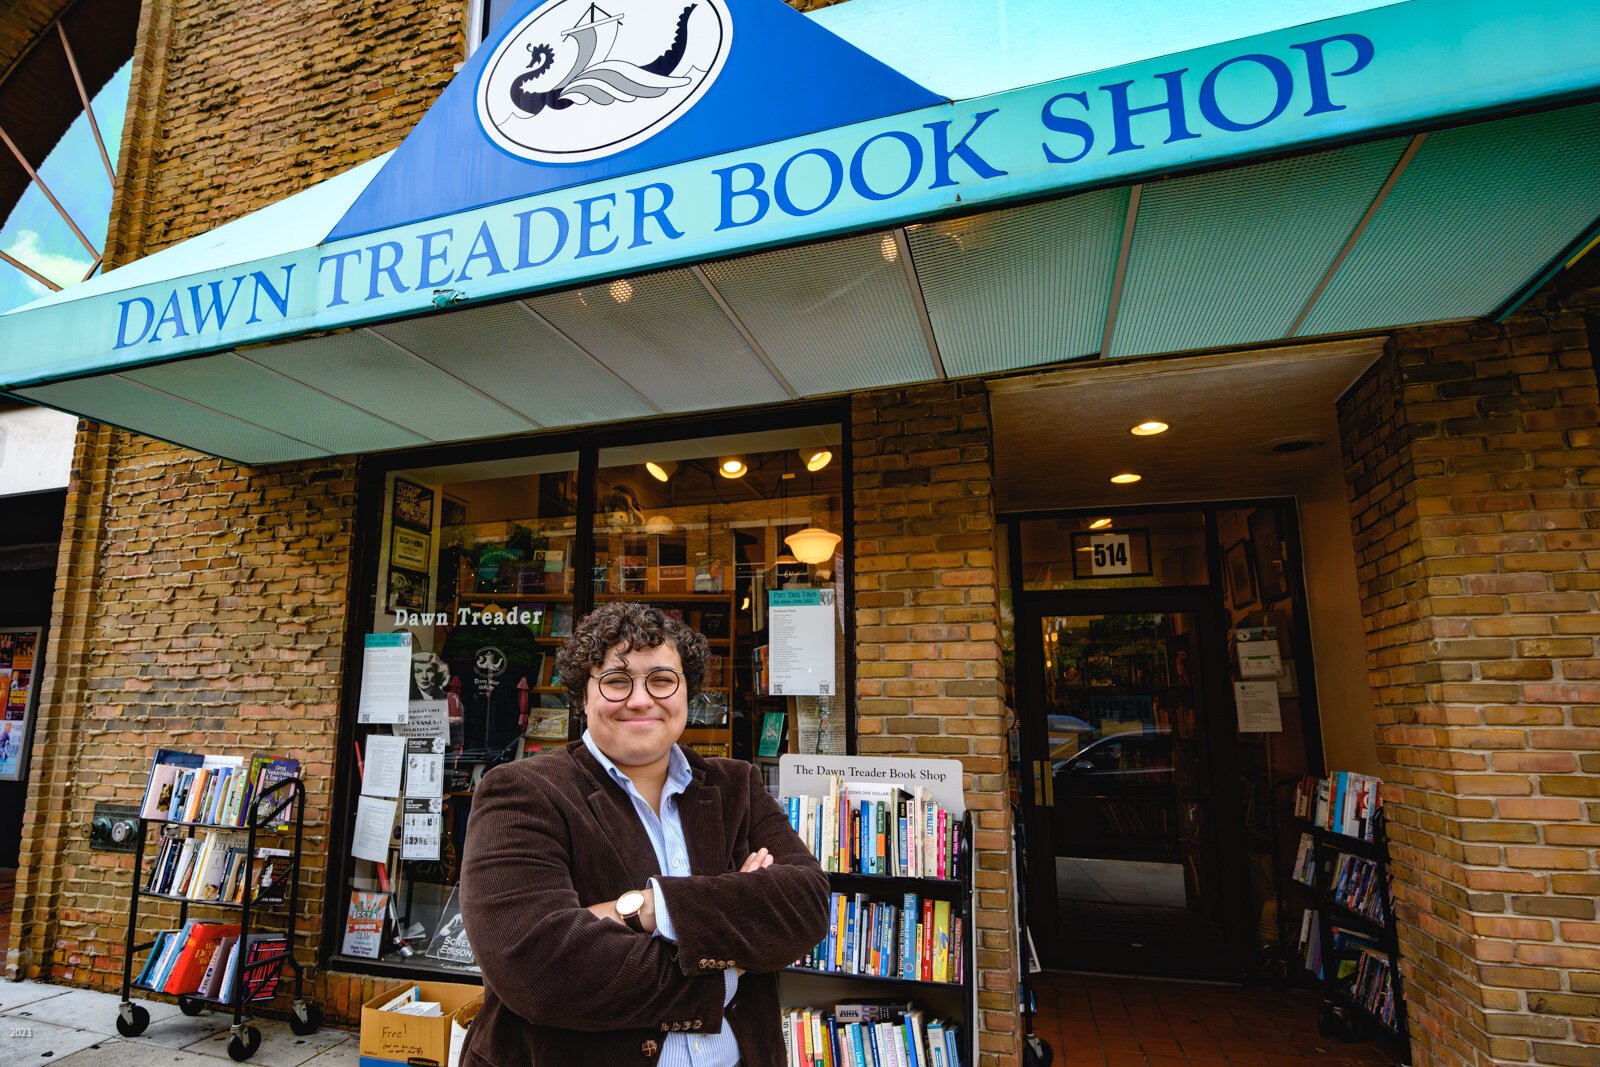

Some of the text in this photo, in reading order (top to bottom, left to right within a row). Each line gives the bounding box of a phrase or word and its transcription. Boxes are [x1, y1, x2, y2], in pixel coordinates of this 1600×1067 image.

[114, 33, 1375, 350] DAWN TREADER BOOK SHOP
[1093, 542, 1127, 567] 514
[394, 606, 542, 626] Dawn Treader
[794, 764, 946, 782] The Dawn Treader Book Shop
[440, 945, 472, 958] EDISON
[382, 1022, 406, 1039] Free!
